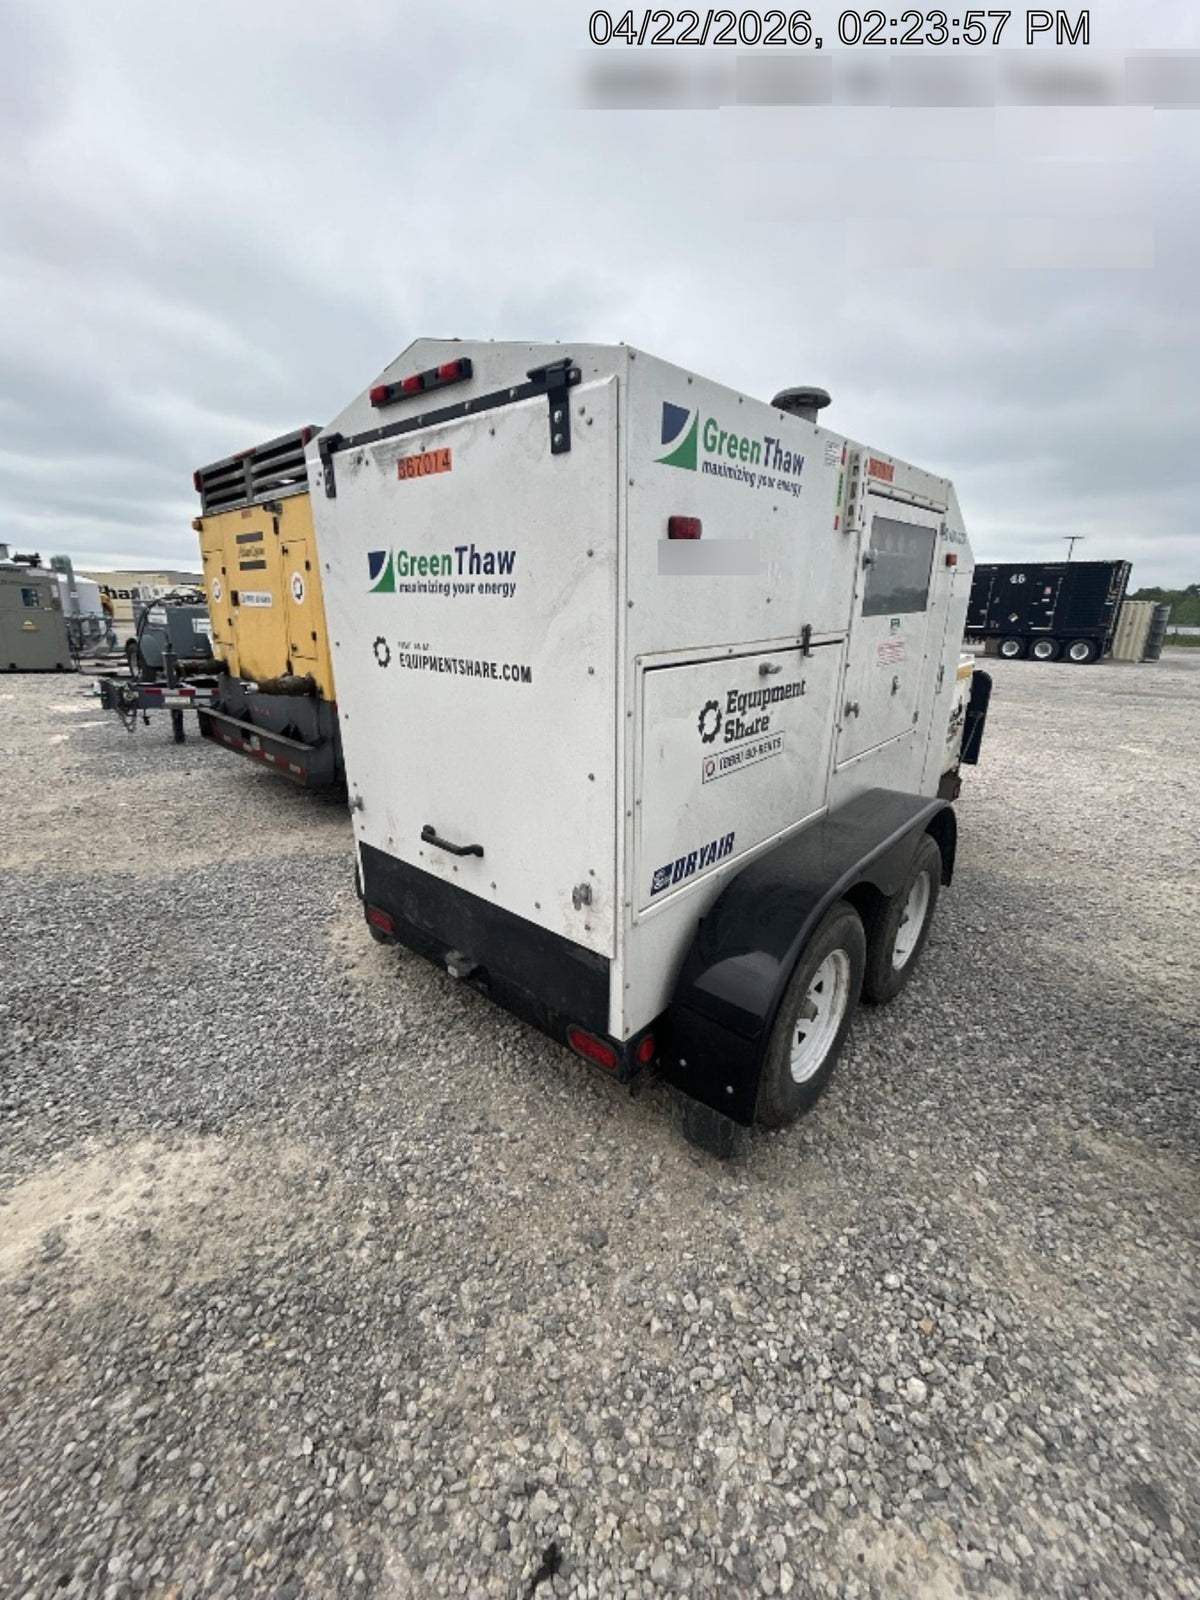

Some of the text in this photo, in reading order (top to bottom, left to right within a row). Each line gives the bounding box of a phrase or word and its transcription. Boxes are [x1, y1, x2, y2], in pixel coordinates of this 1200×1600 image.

[452, 582, 476, 598] your
[478, 582, 516, 598] energy
[399, 652, 532, 683] EQUIPMENTSHARE.COM
[726, 680, 806, 716] Equipment
[723, 715, 770, 743] Share
[672, 832, 735, 884] DRYAIR
